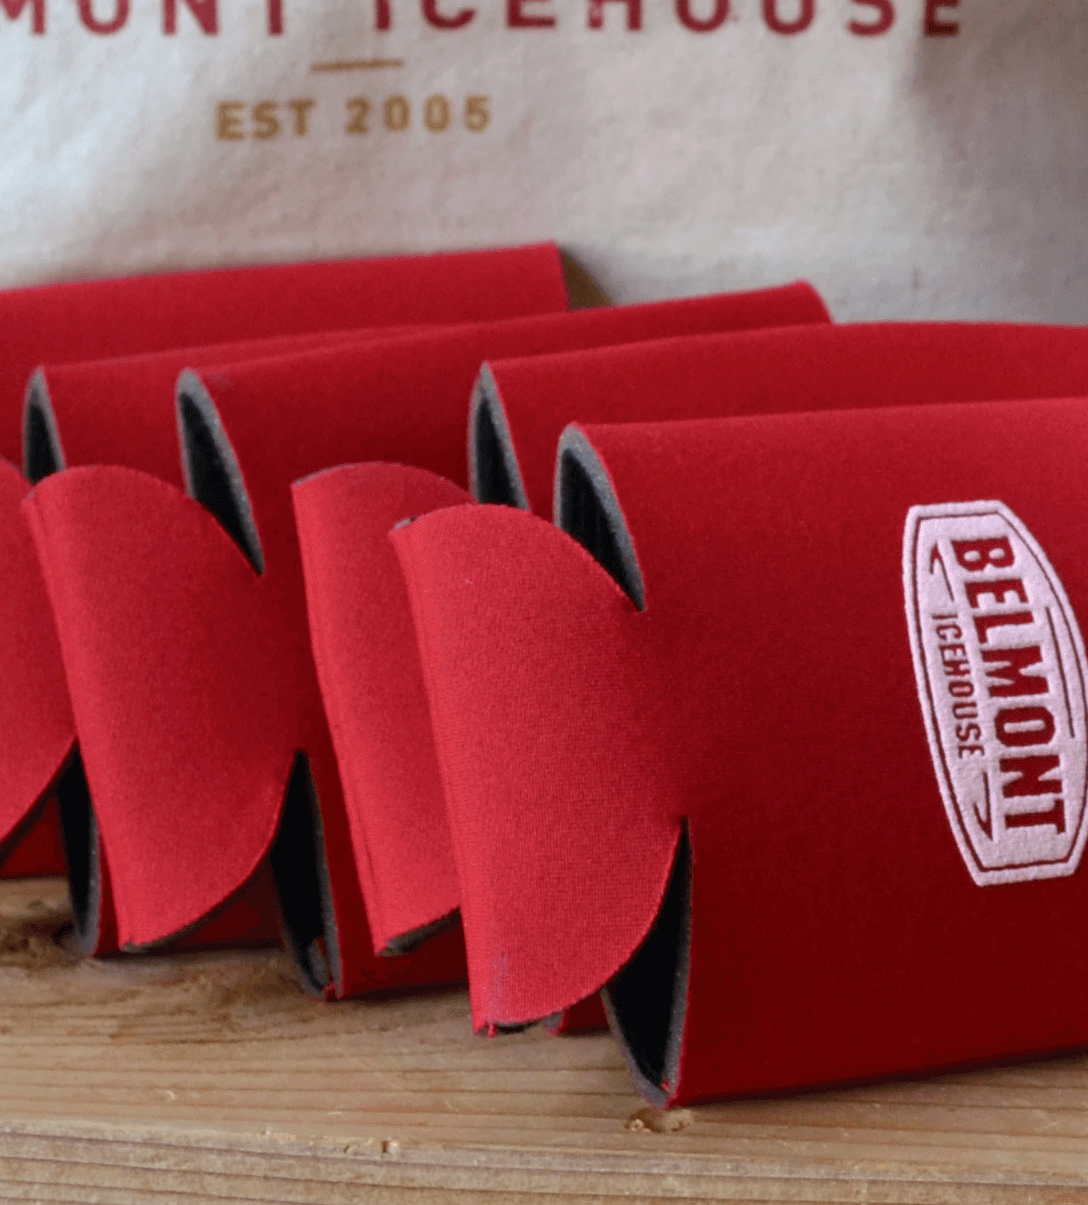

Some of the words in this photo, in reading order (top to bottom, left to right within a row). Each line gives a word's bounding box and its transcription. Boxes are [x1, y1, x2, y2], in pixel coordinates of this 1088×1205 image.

[217, 99, 316, 141] EST
[345, 96, 492, 135] 2005
[931, 612, 985, 759] ICEHOUSE
[950, 536, 1067, 835] BELMONT
